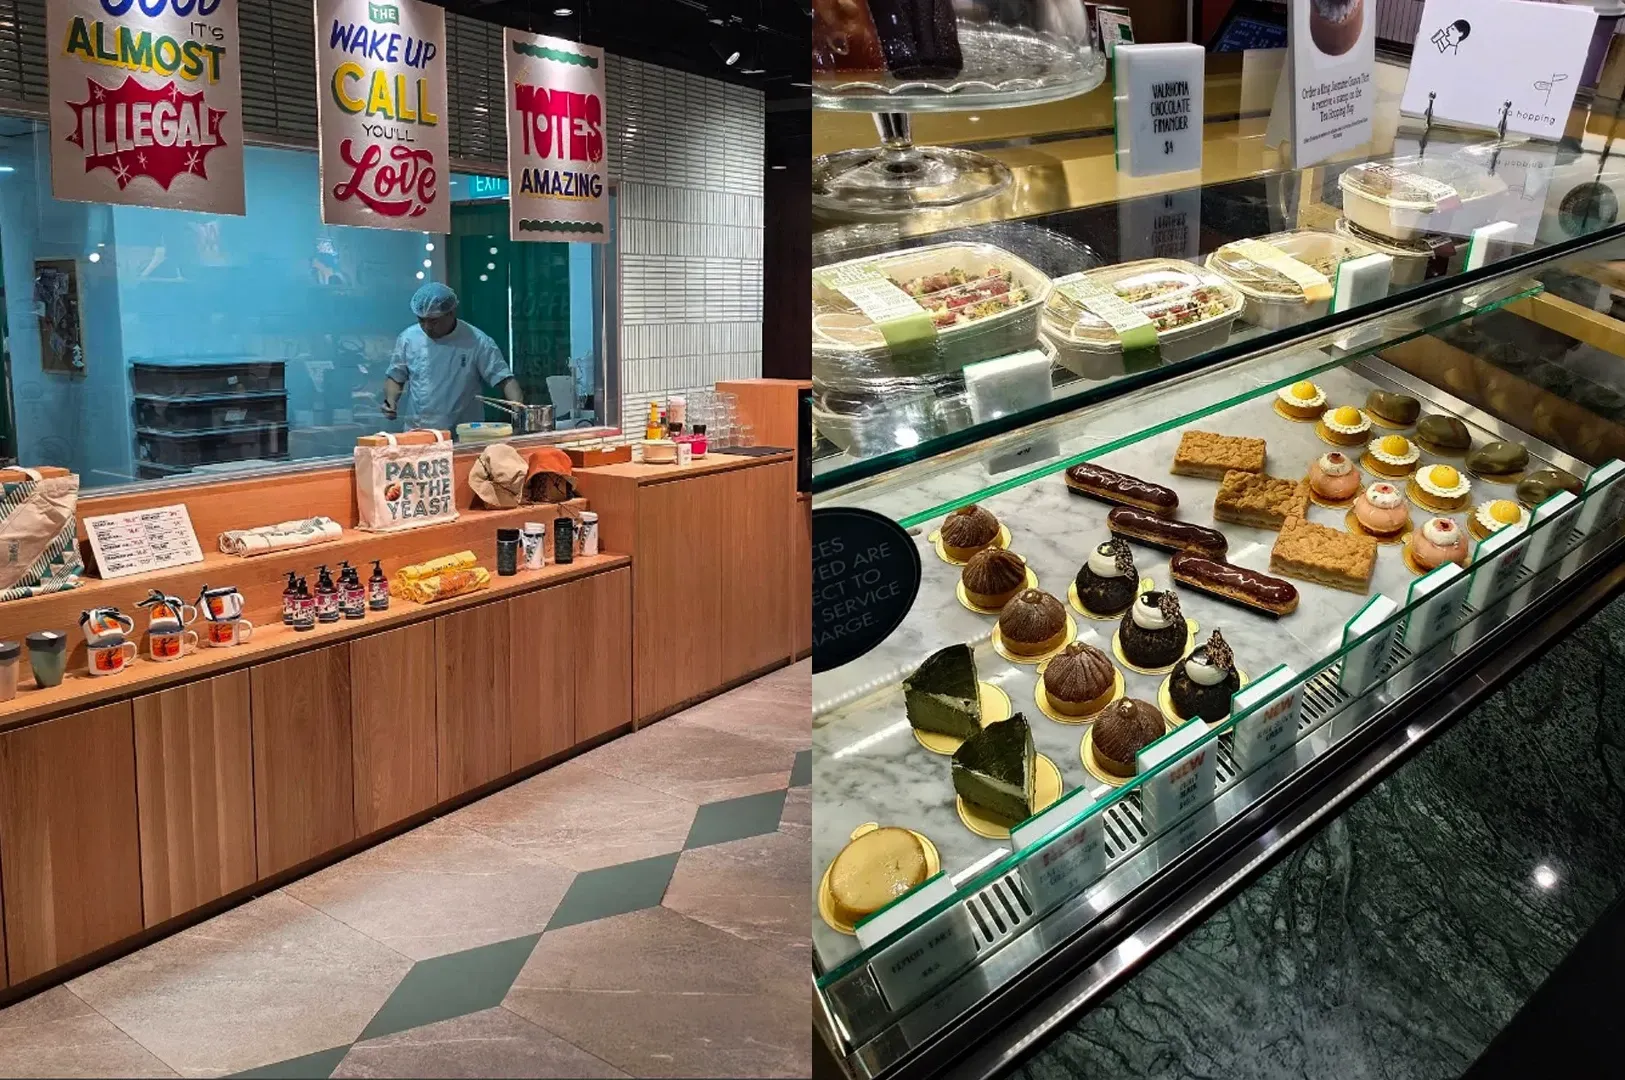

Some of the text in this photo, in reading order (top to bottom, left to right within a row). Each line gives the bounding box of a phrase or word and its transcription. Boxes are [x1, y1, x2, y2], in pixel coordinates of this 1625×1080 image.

[372, 8, 396, 20] THE
[190, 21, 224, 40] IT'S
[63, 15, 226, 84] ALMOST
[330, 19, 437, 69] WAKE UP
[331, 61, 439, 126] CALL
[1152, 80, 1190, 99] VALRHONA
[1150, 98, 1191, 117] CHOCOLATE
[1516, 110, 1556, 126] hopping
[81, 99, 217, 158] ILLEGAL
[362, 123, 415, 142] YOU'LL
[515, 83, 603, 164] TOTES
[1153, 115, 1189, 134] FINANCIER
[333, 139, 437, 216] Love
[519, 168, 603, 200] AMAZING
[385, 458, 451, 481] PARIS
[416, 478, 451, 499] THE
[387, 495, 451, 520] YEAST
[853, 542, 892, 568] ARE
[851, 569, 881, 589] TO
[821, 580, 901, 622] SERVICE
